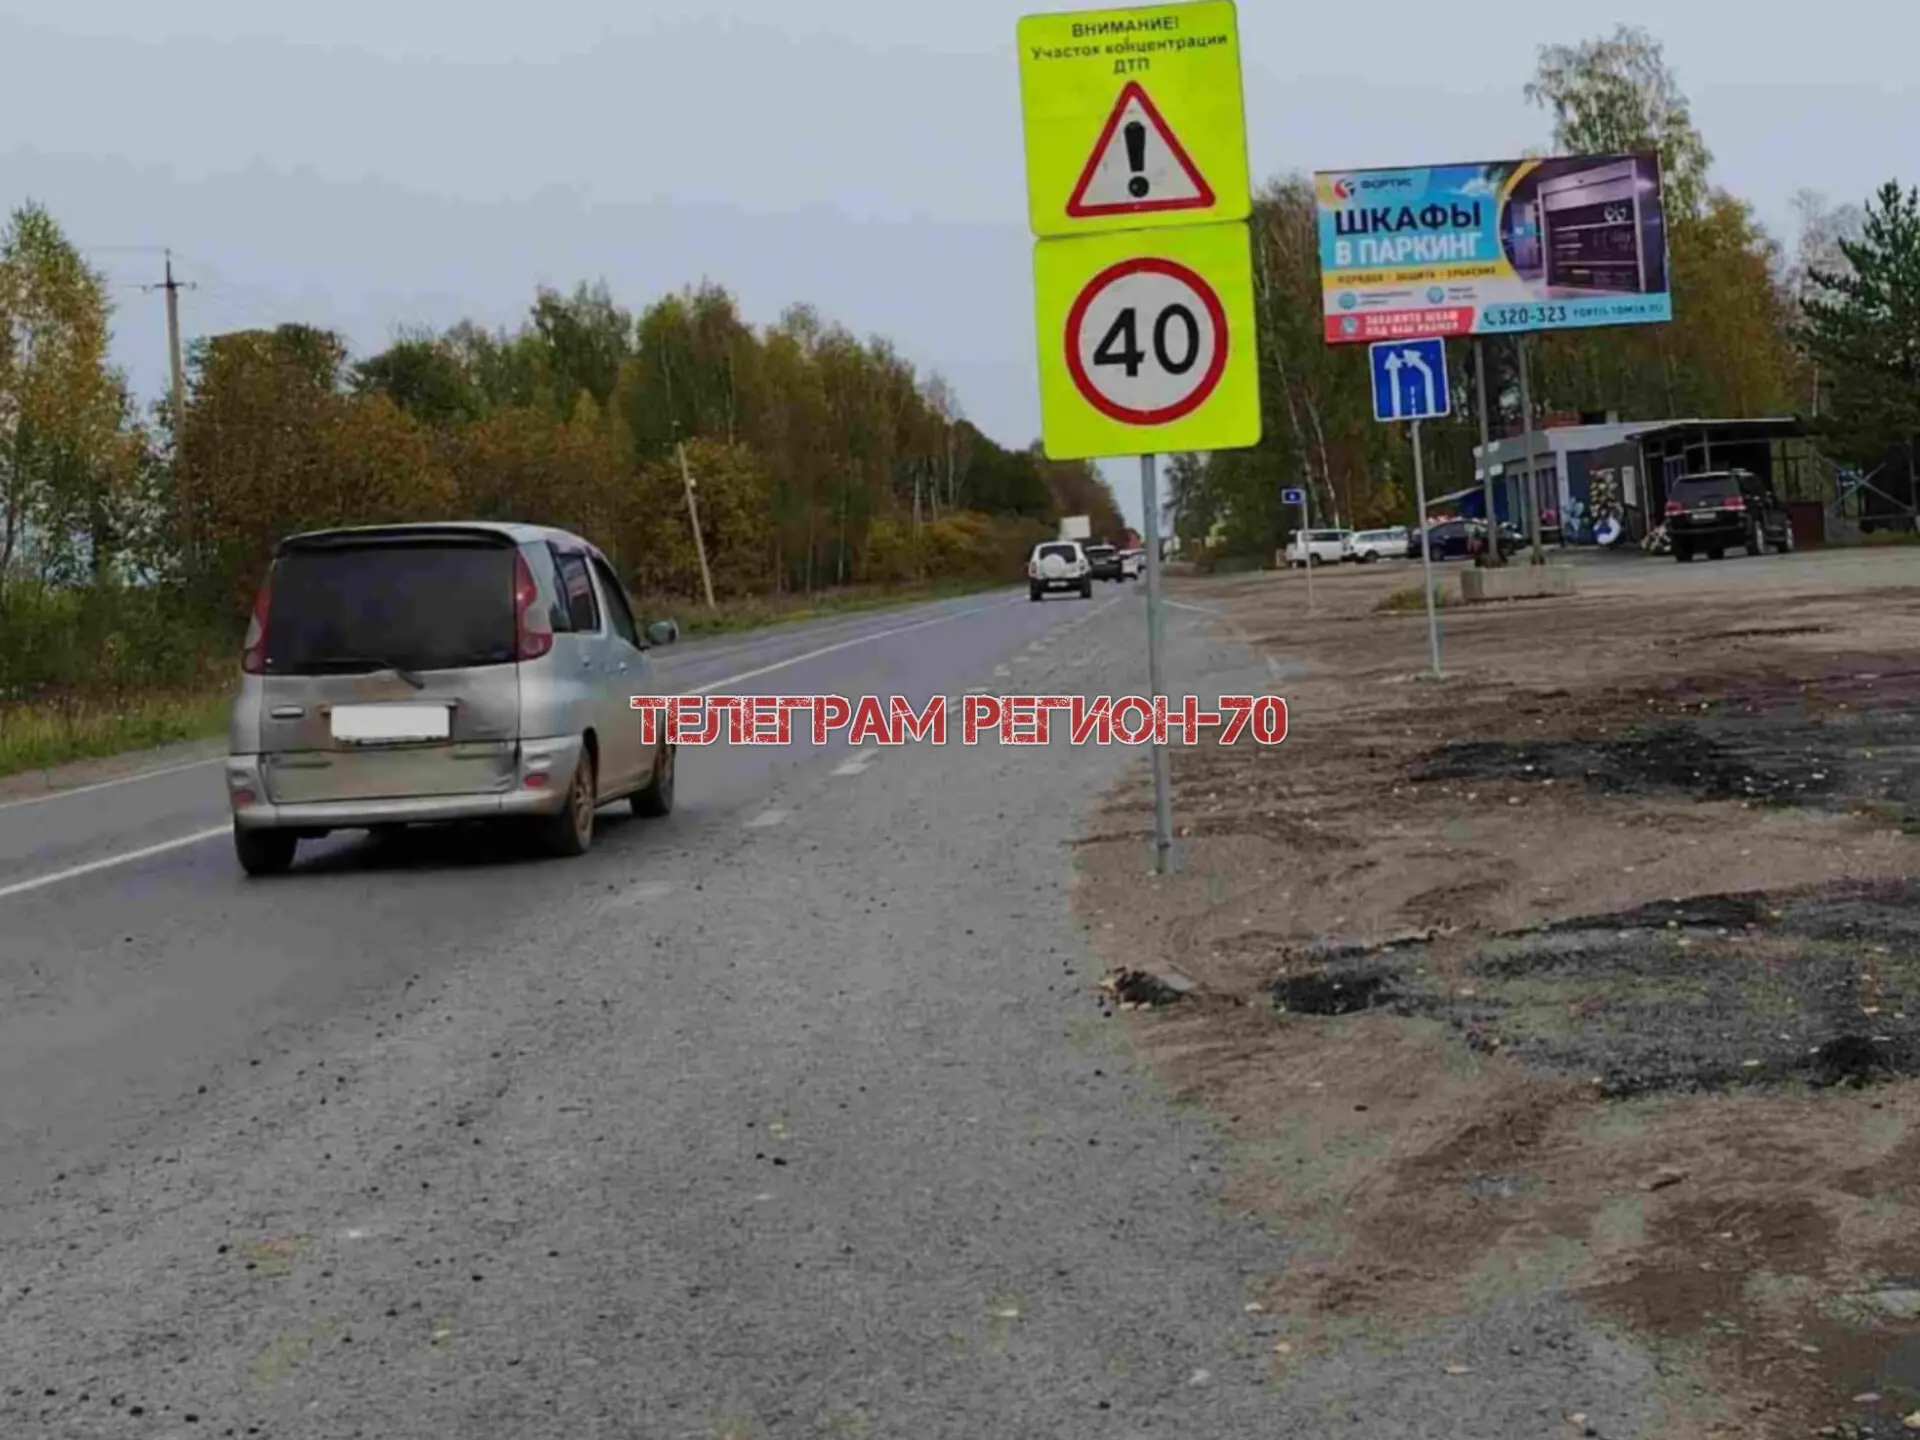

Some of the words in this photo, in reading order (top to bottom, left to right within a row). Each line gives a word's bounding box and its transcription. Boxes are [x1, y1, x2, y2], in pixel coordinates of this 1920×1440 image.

[1071, 16, 1179, 38] ВНИМАНИЕ!
[1032, 45, 1100, 61] Участок
[1105, 34, 1228, 55] концентрации
[1113, 57, 1150, 74] ДТП
[1335, 201, 1480, 236] ШКАФЫ
[1335, 240, 1352, 266] В
[1359, 231, 1483, 265] ПАРКИНГ
[1499, 305, 1567, 326] 320-323
[1093, 303, 1199, 378] 40
